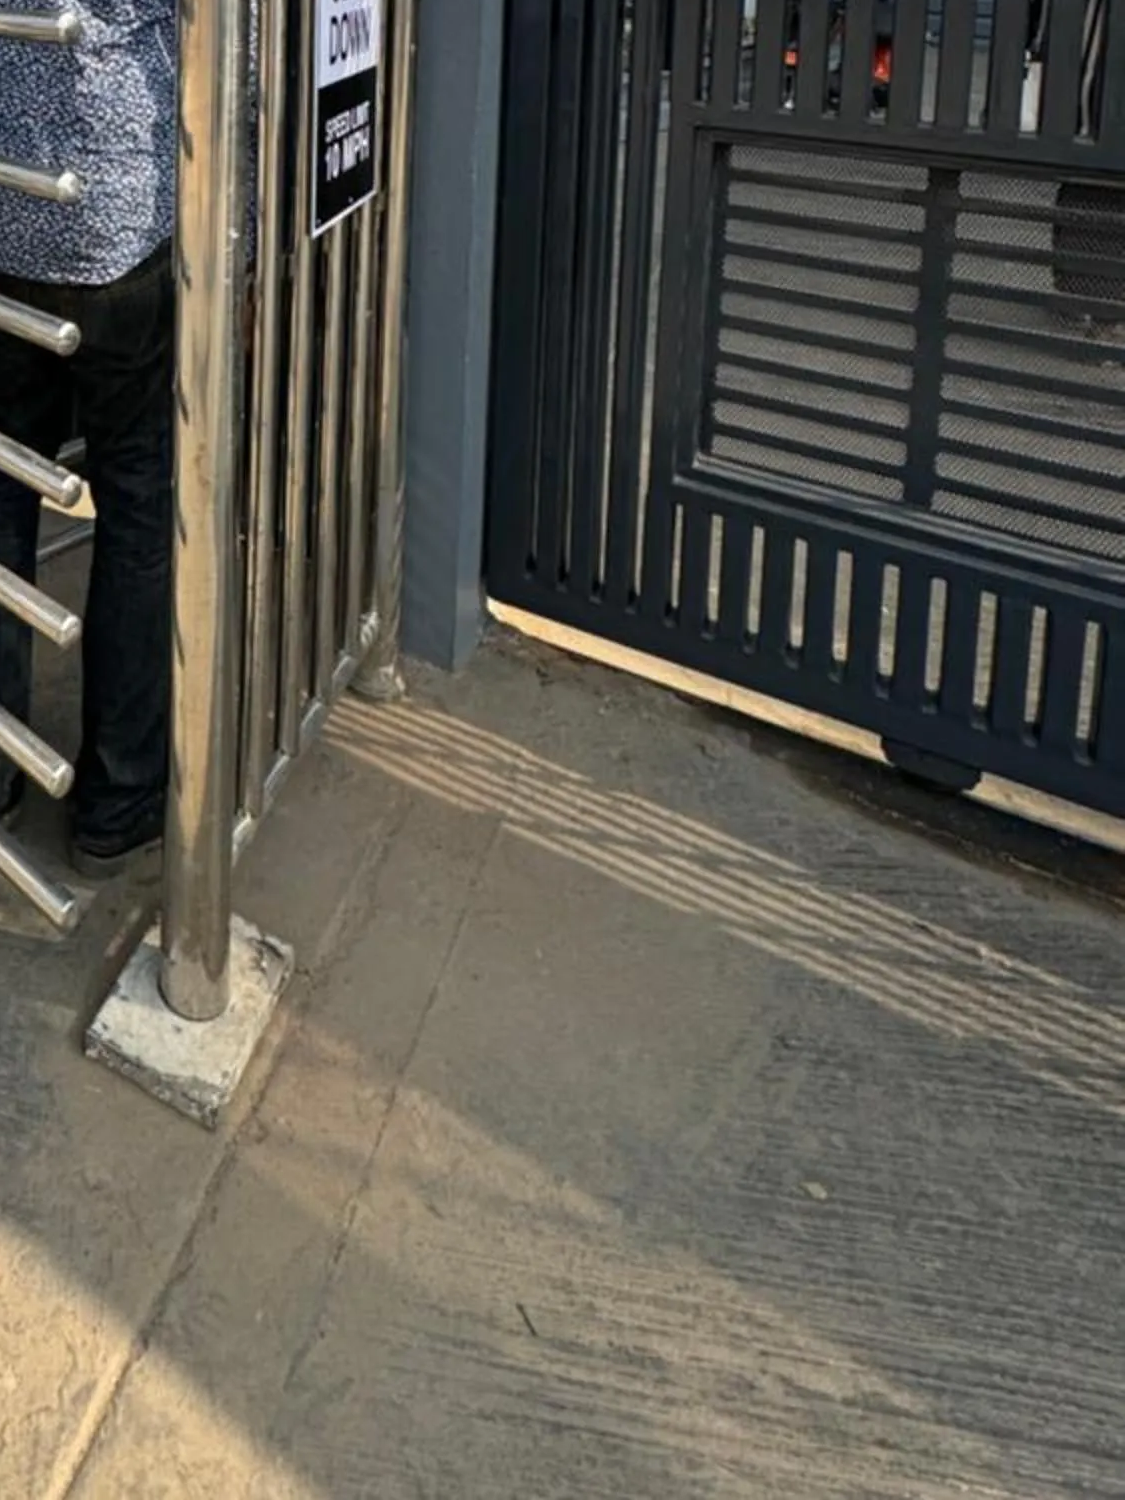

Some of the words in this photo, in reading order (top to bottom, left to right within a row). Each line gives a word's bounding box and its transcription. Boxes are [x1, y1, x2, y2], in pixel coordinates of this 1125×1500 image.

[329, 6, 371, 65] DOWN
[325, 110, 350, 143] SPEED
[325, 142, 341, 181] 10
[342, 125, 370, 173] MPH
